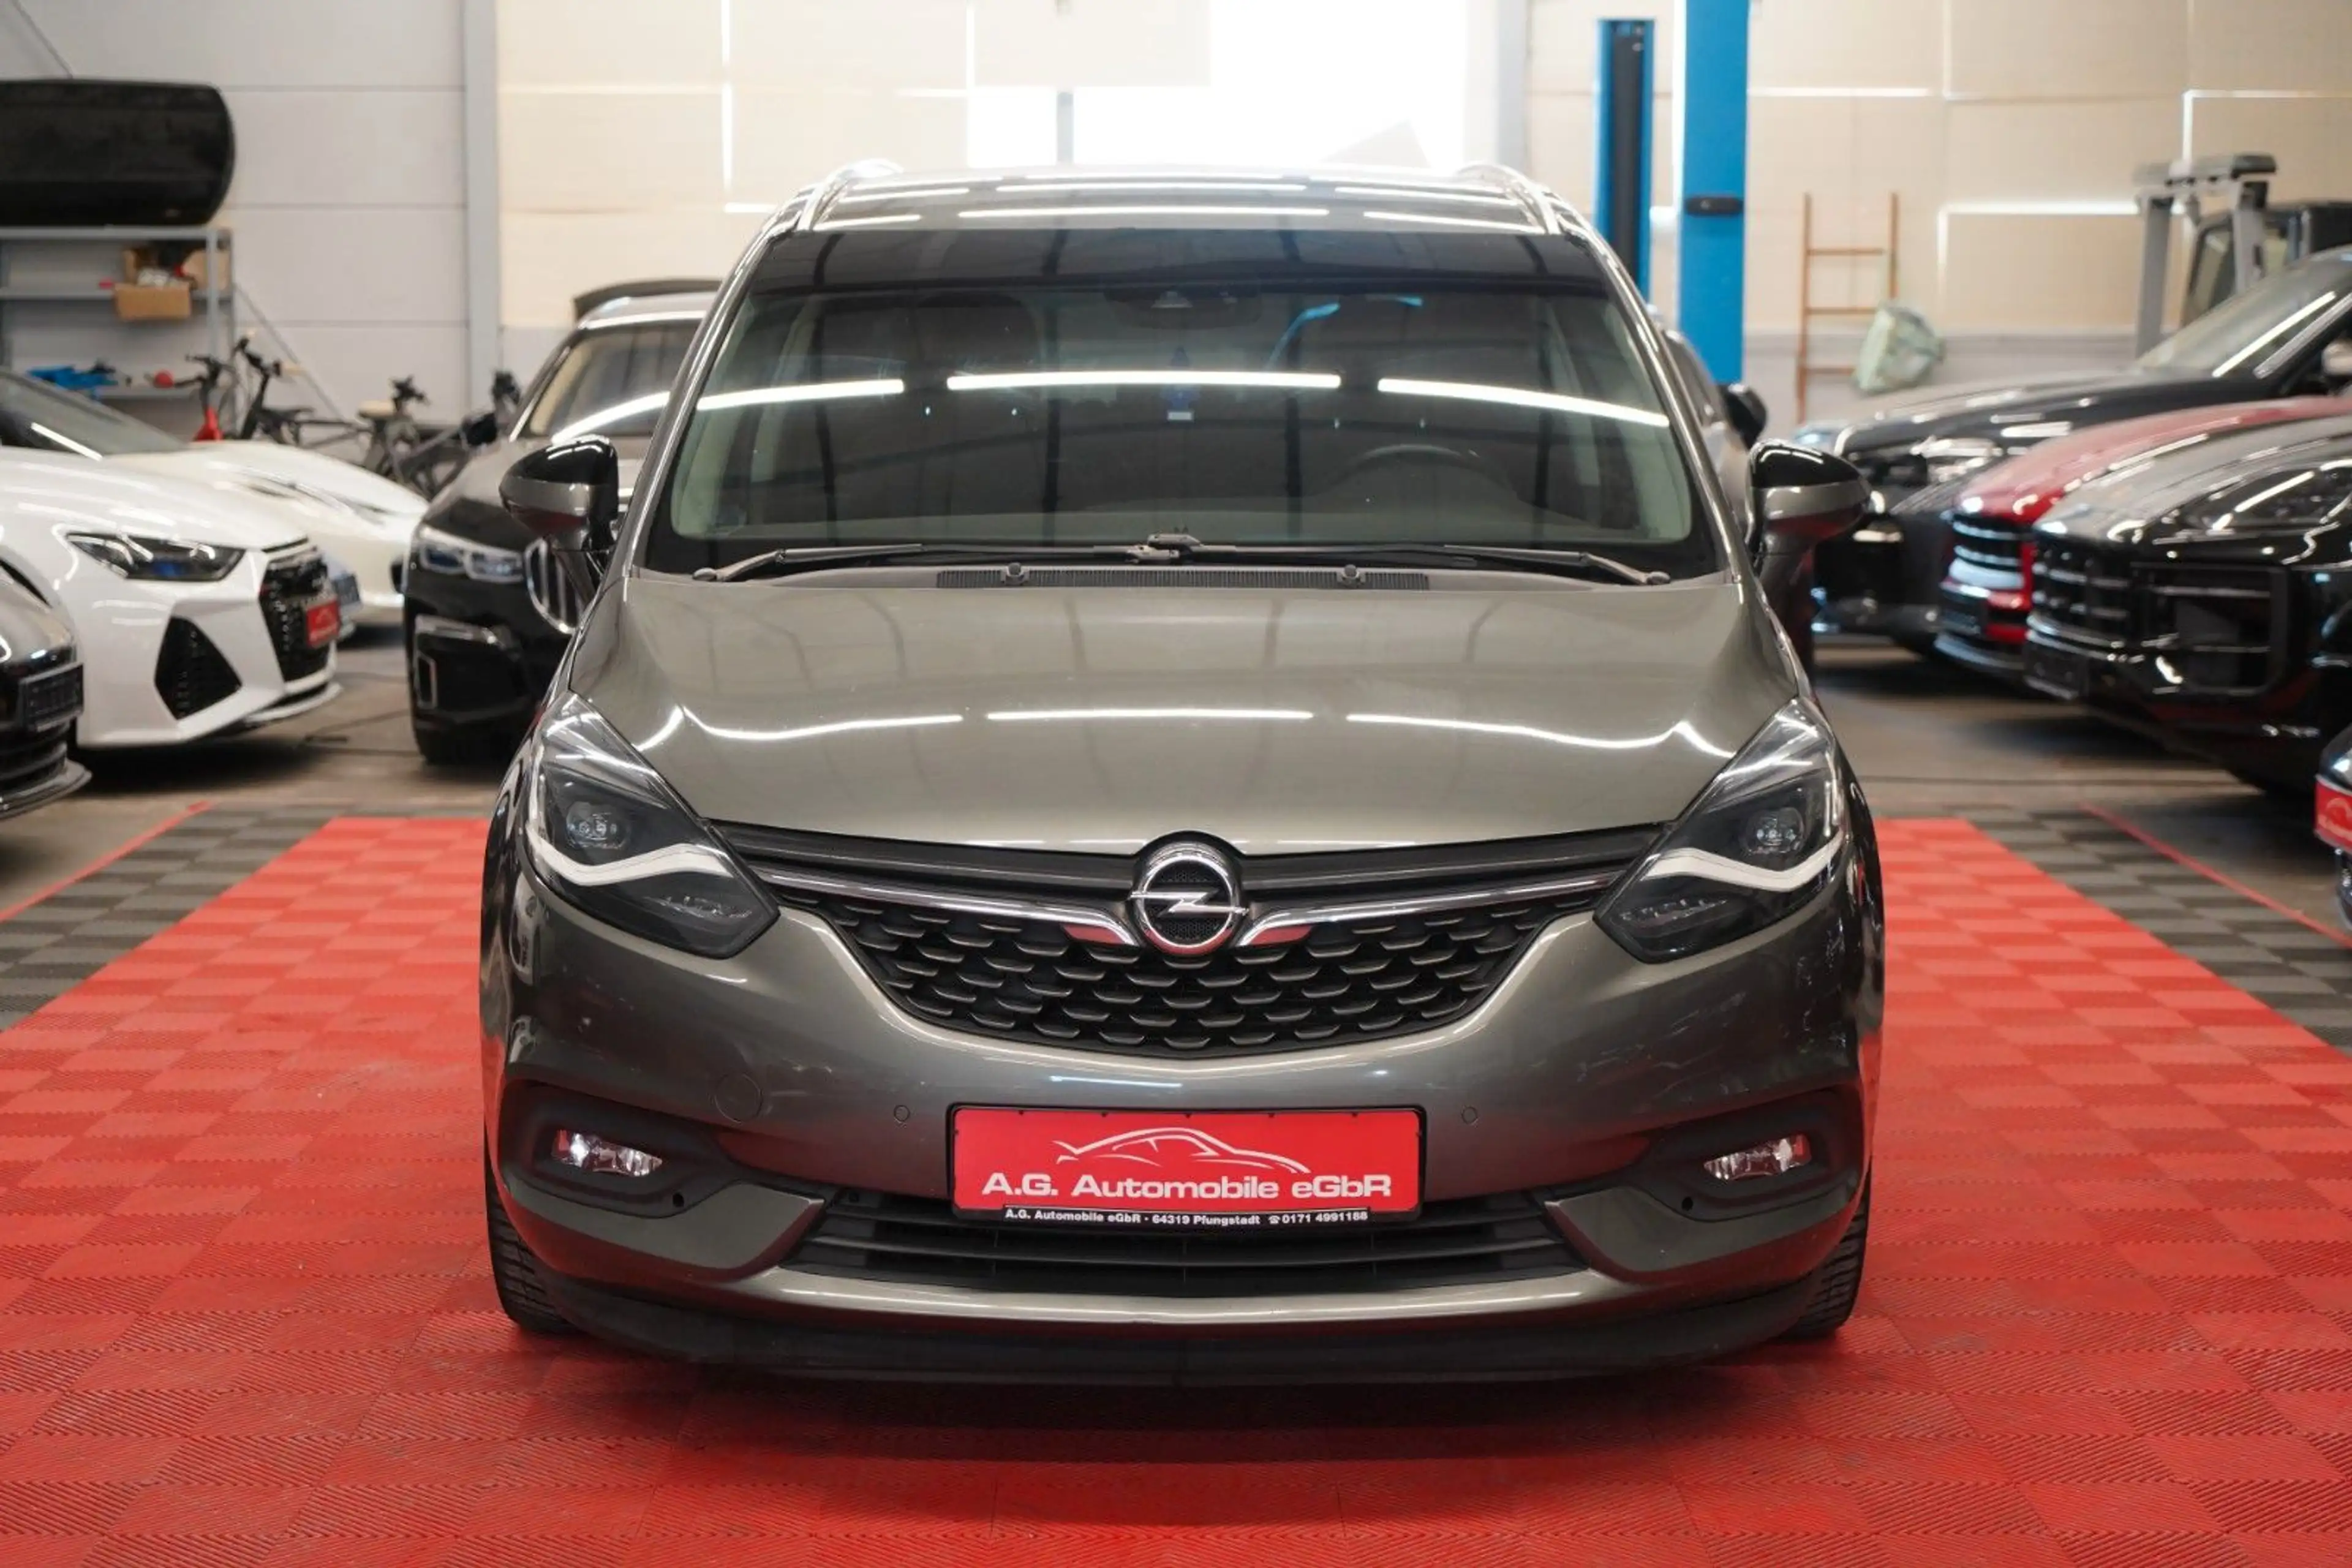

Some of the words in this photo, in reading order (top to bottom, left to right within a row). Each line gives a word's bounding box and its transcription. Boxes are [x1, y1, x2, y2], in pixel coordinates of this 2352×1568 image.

[982, 1172, 1059, 1196] A.G.
[1071, 1174, 1279, 1199] Automobile
[1292, 1174, 1392, 1198] eGbR
[1005, 1208, 1031, 1219] A.G.
[1035, 1210, 1104, 1223] Automobile
[1108, 1213, 1141, 1223] eGbR
[1152, 1214, 1190, 1224] 64319
[1193, 1215, 1261, 1226] Pfungstadt
[1281, 1213, 1311, 1224] 0171
